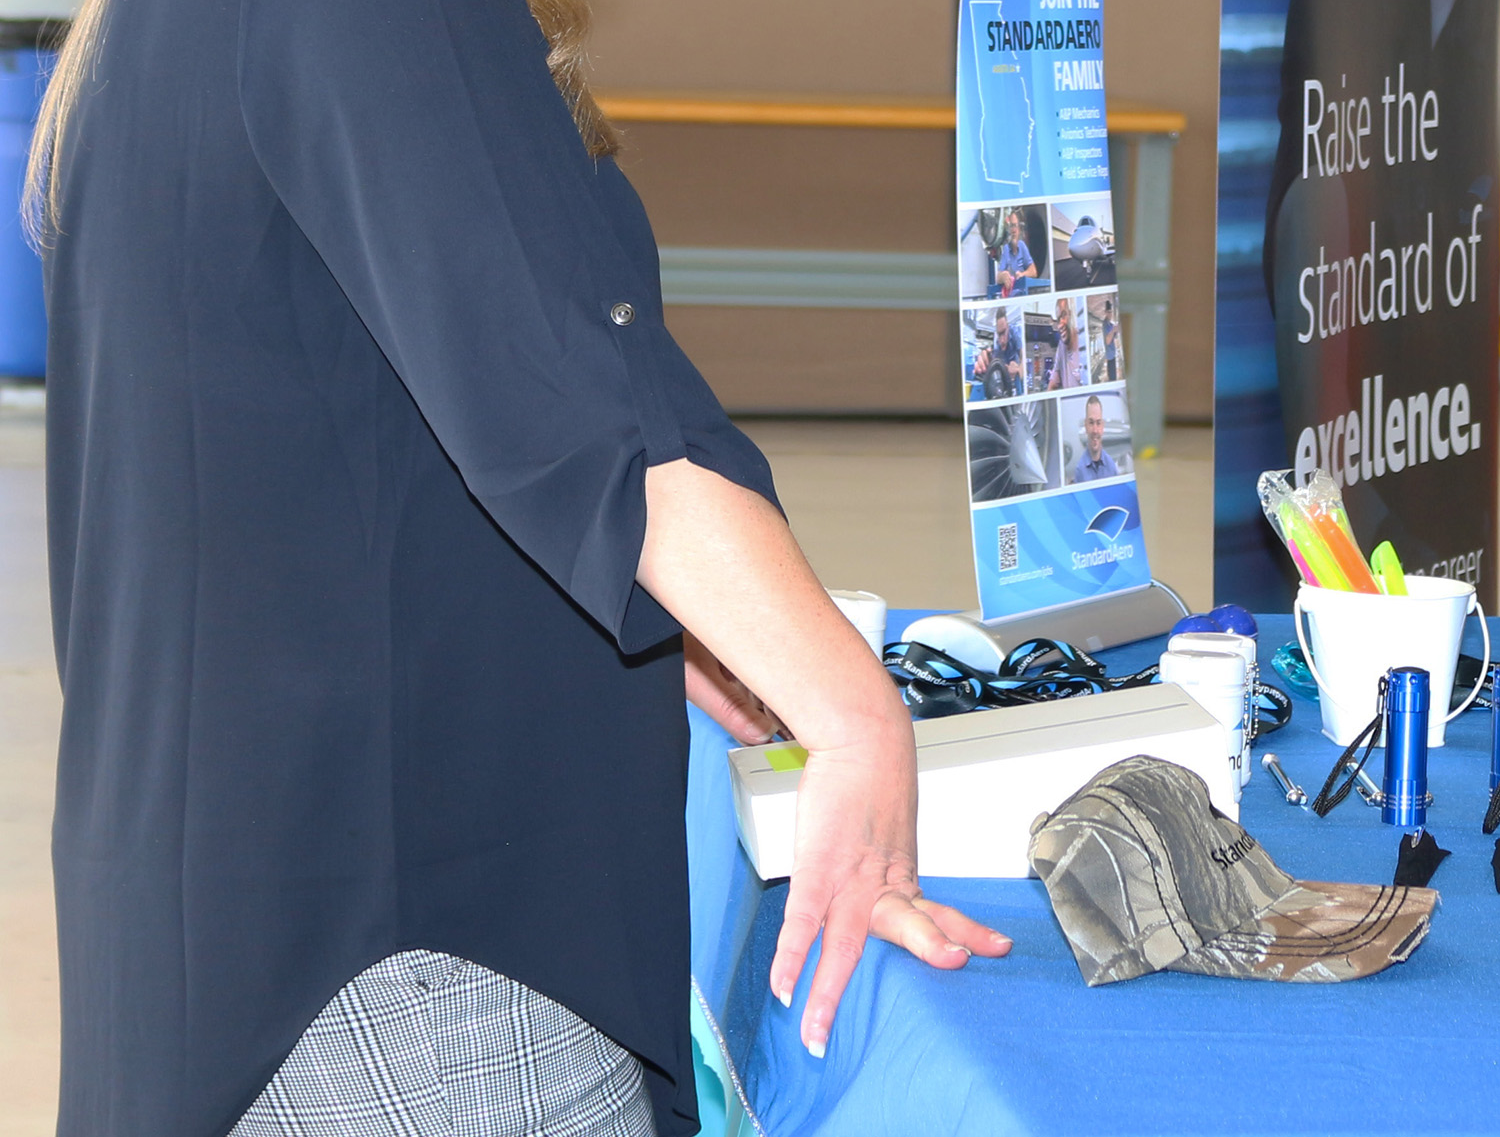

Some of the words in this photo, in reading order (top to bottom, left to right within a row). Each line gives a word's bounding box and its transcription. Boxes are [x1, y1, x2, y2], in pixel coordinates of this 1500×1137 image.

[987, 20, 1101, 52] STANDARDAERO
[1053, 60, 1104, 91] FAMILY
[1302, 74, 1371, 179] Raise
[1382, 63, 1440, 166] the
[1298, 213, 1433, 344] standard
[1446, 204, 1483, 307] of
[1295, 375, 1482, 490] excellence.
[1072, 544, 1134, 570] StandardAero
